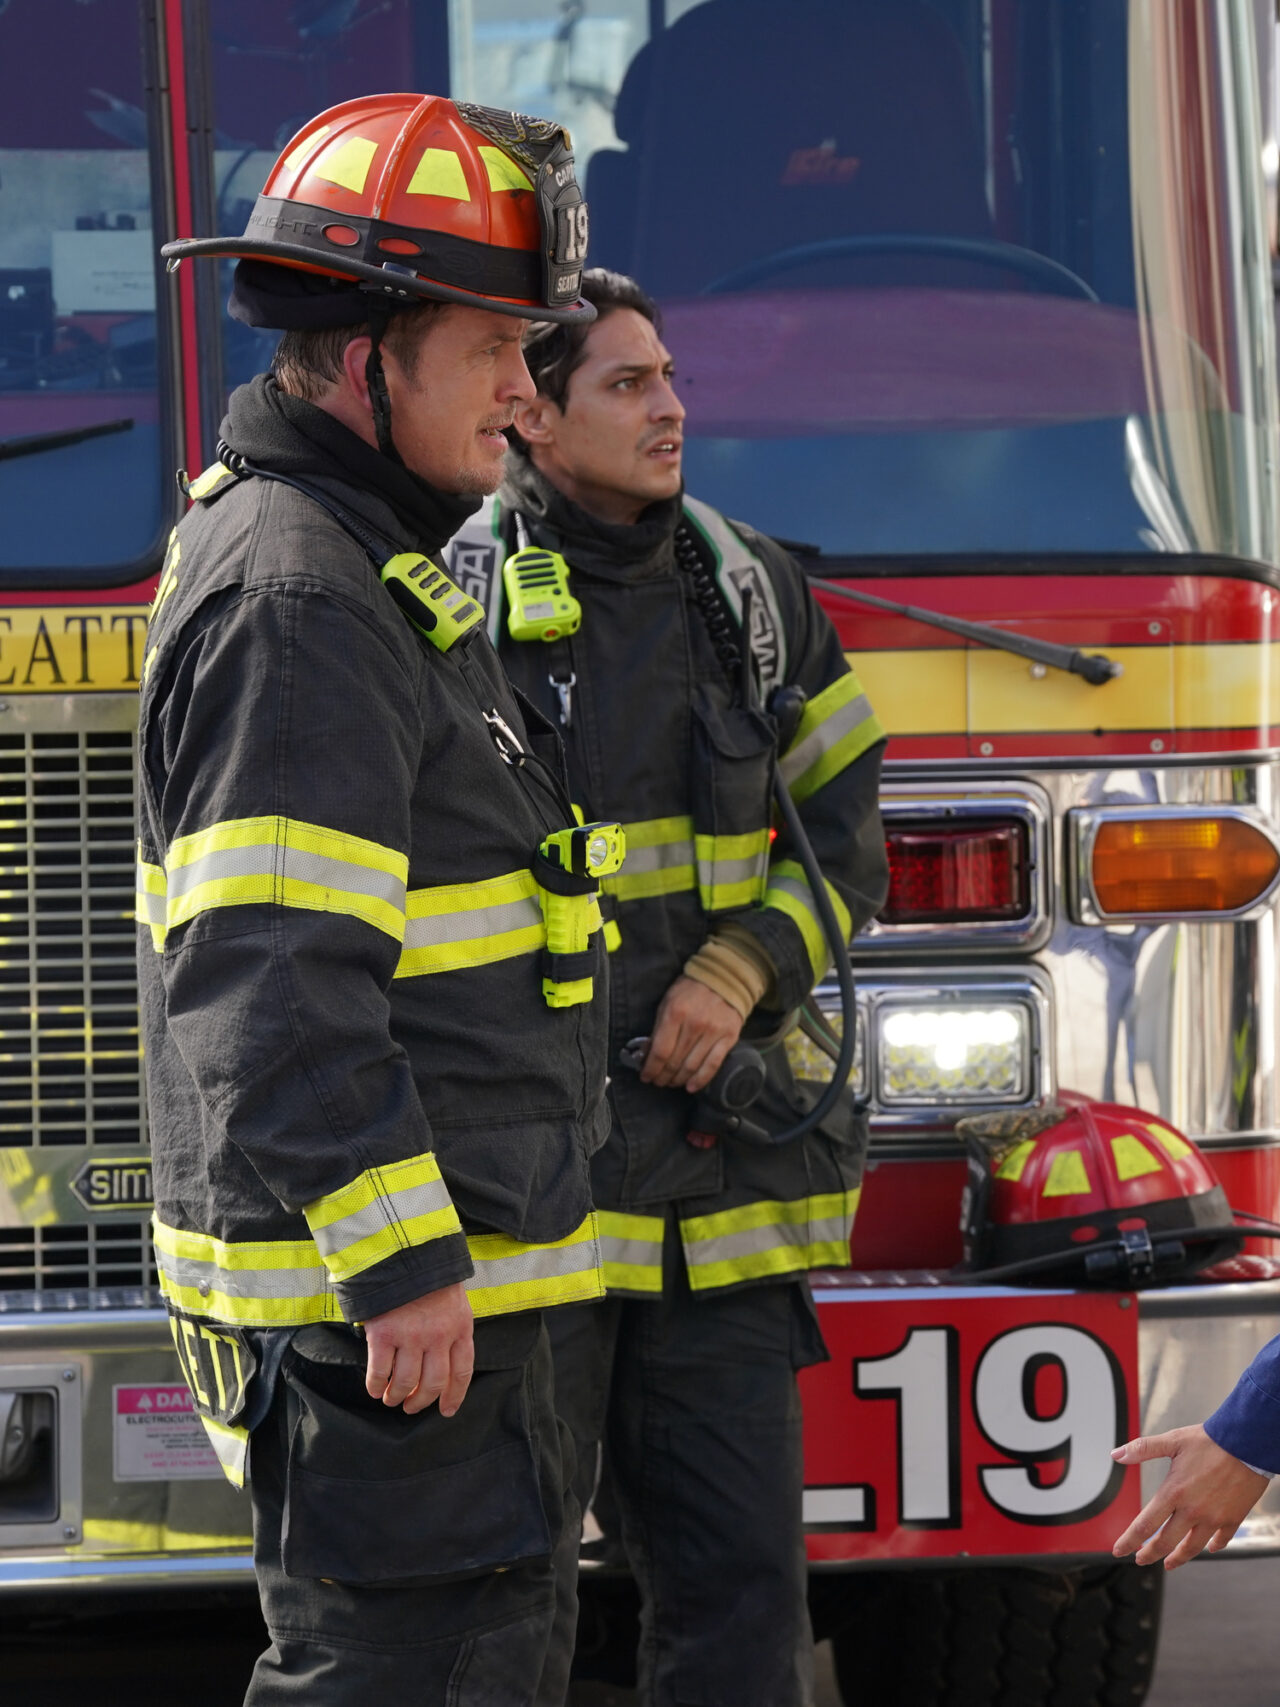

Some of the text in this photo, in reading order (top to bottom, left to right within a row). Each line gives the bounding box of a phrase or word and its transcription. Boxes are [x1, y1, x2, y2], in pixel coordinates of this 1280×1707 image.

[565, 202, 588, 260] 19
[170, 1316, 243, 1415] ETT
[802, 1320, 1129, 1533] 19
